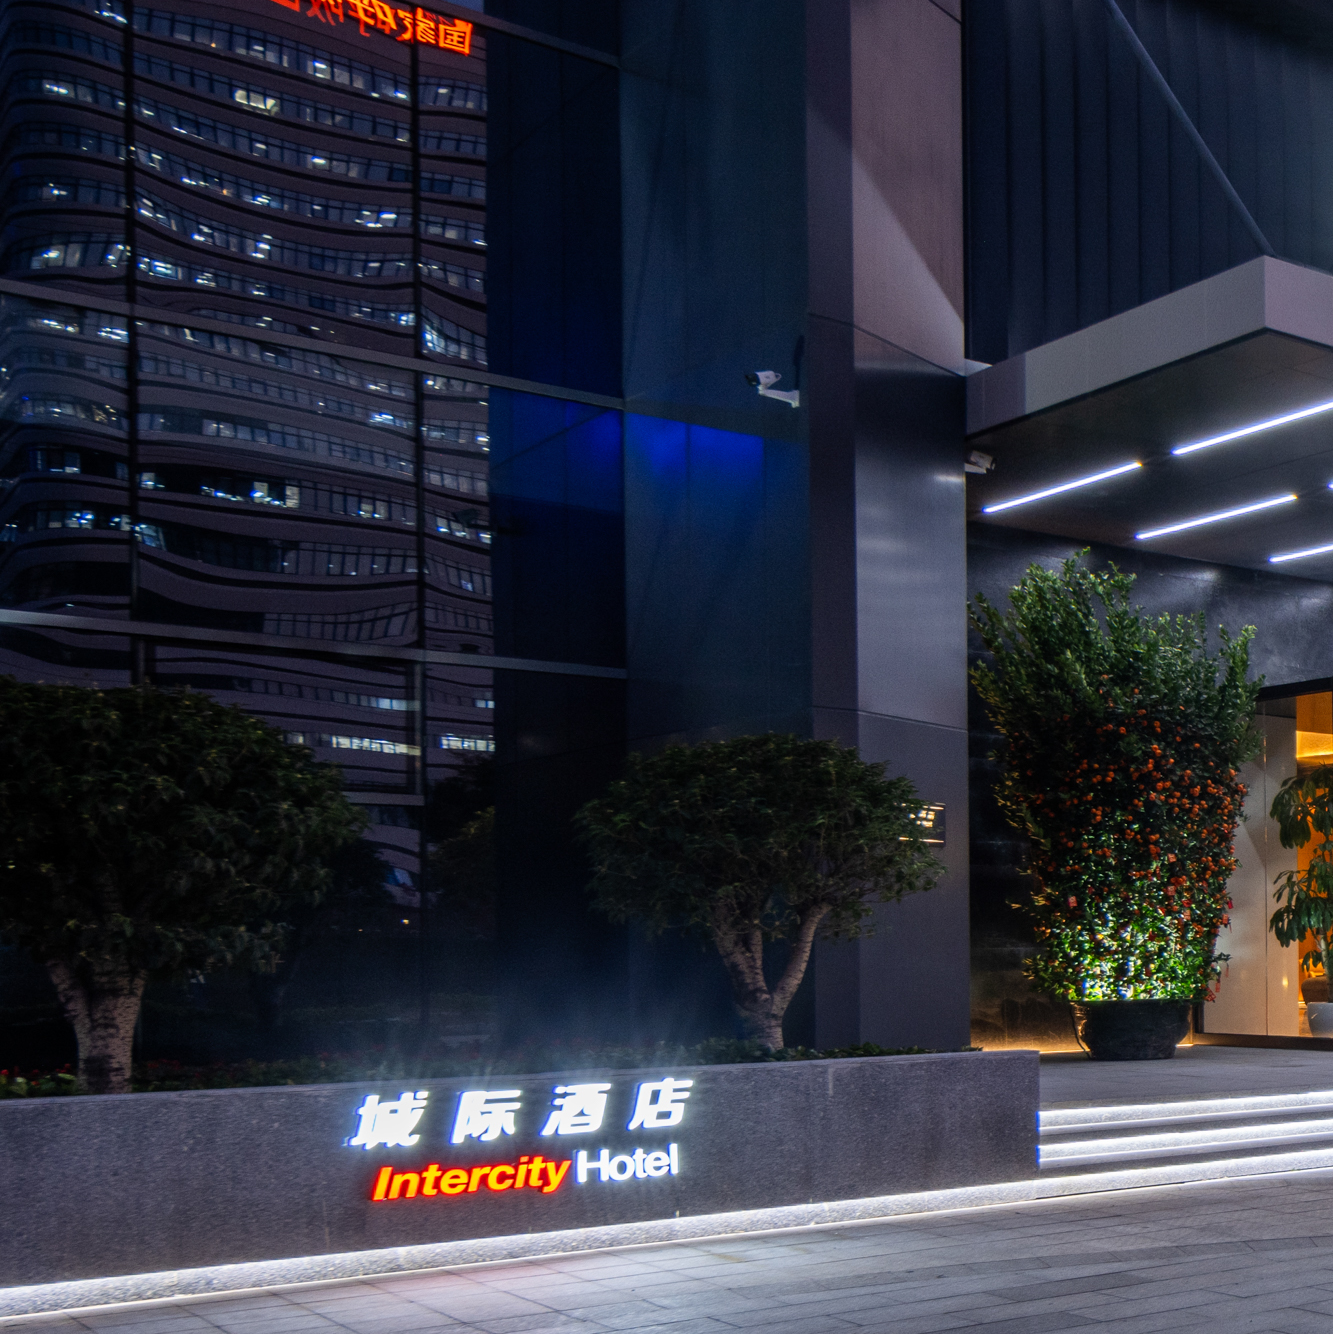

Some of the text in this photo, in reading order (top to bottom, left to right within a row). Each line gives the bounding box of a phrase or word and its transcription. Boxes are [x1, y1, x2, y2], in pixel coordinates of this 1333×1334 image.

[345, 1077, 694, 1149] 城际酒店
[371, 1143, 680, 1203] Intercity Hotel
